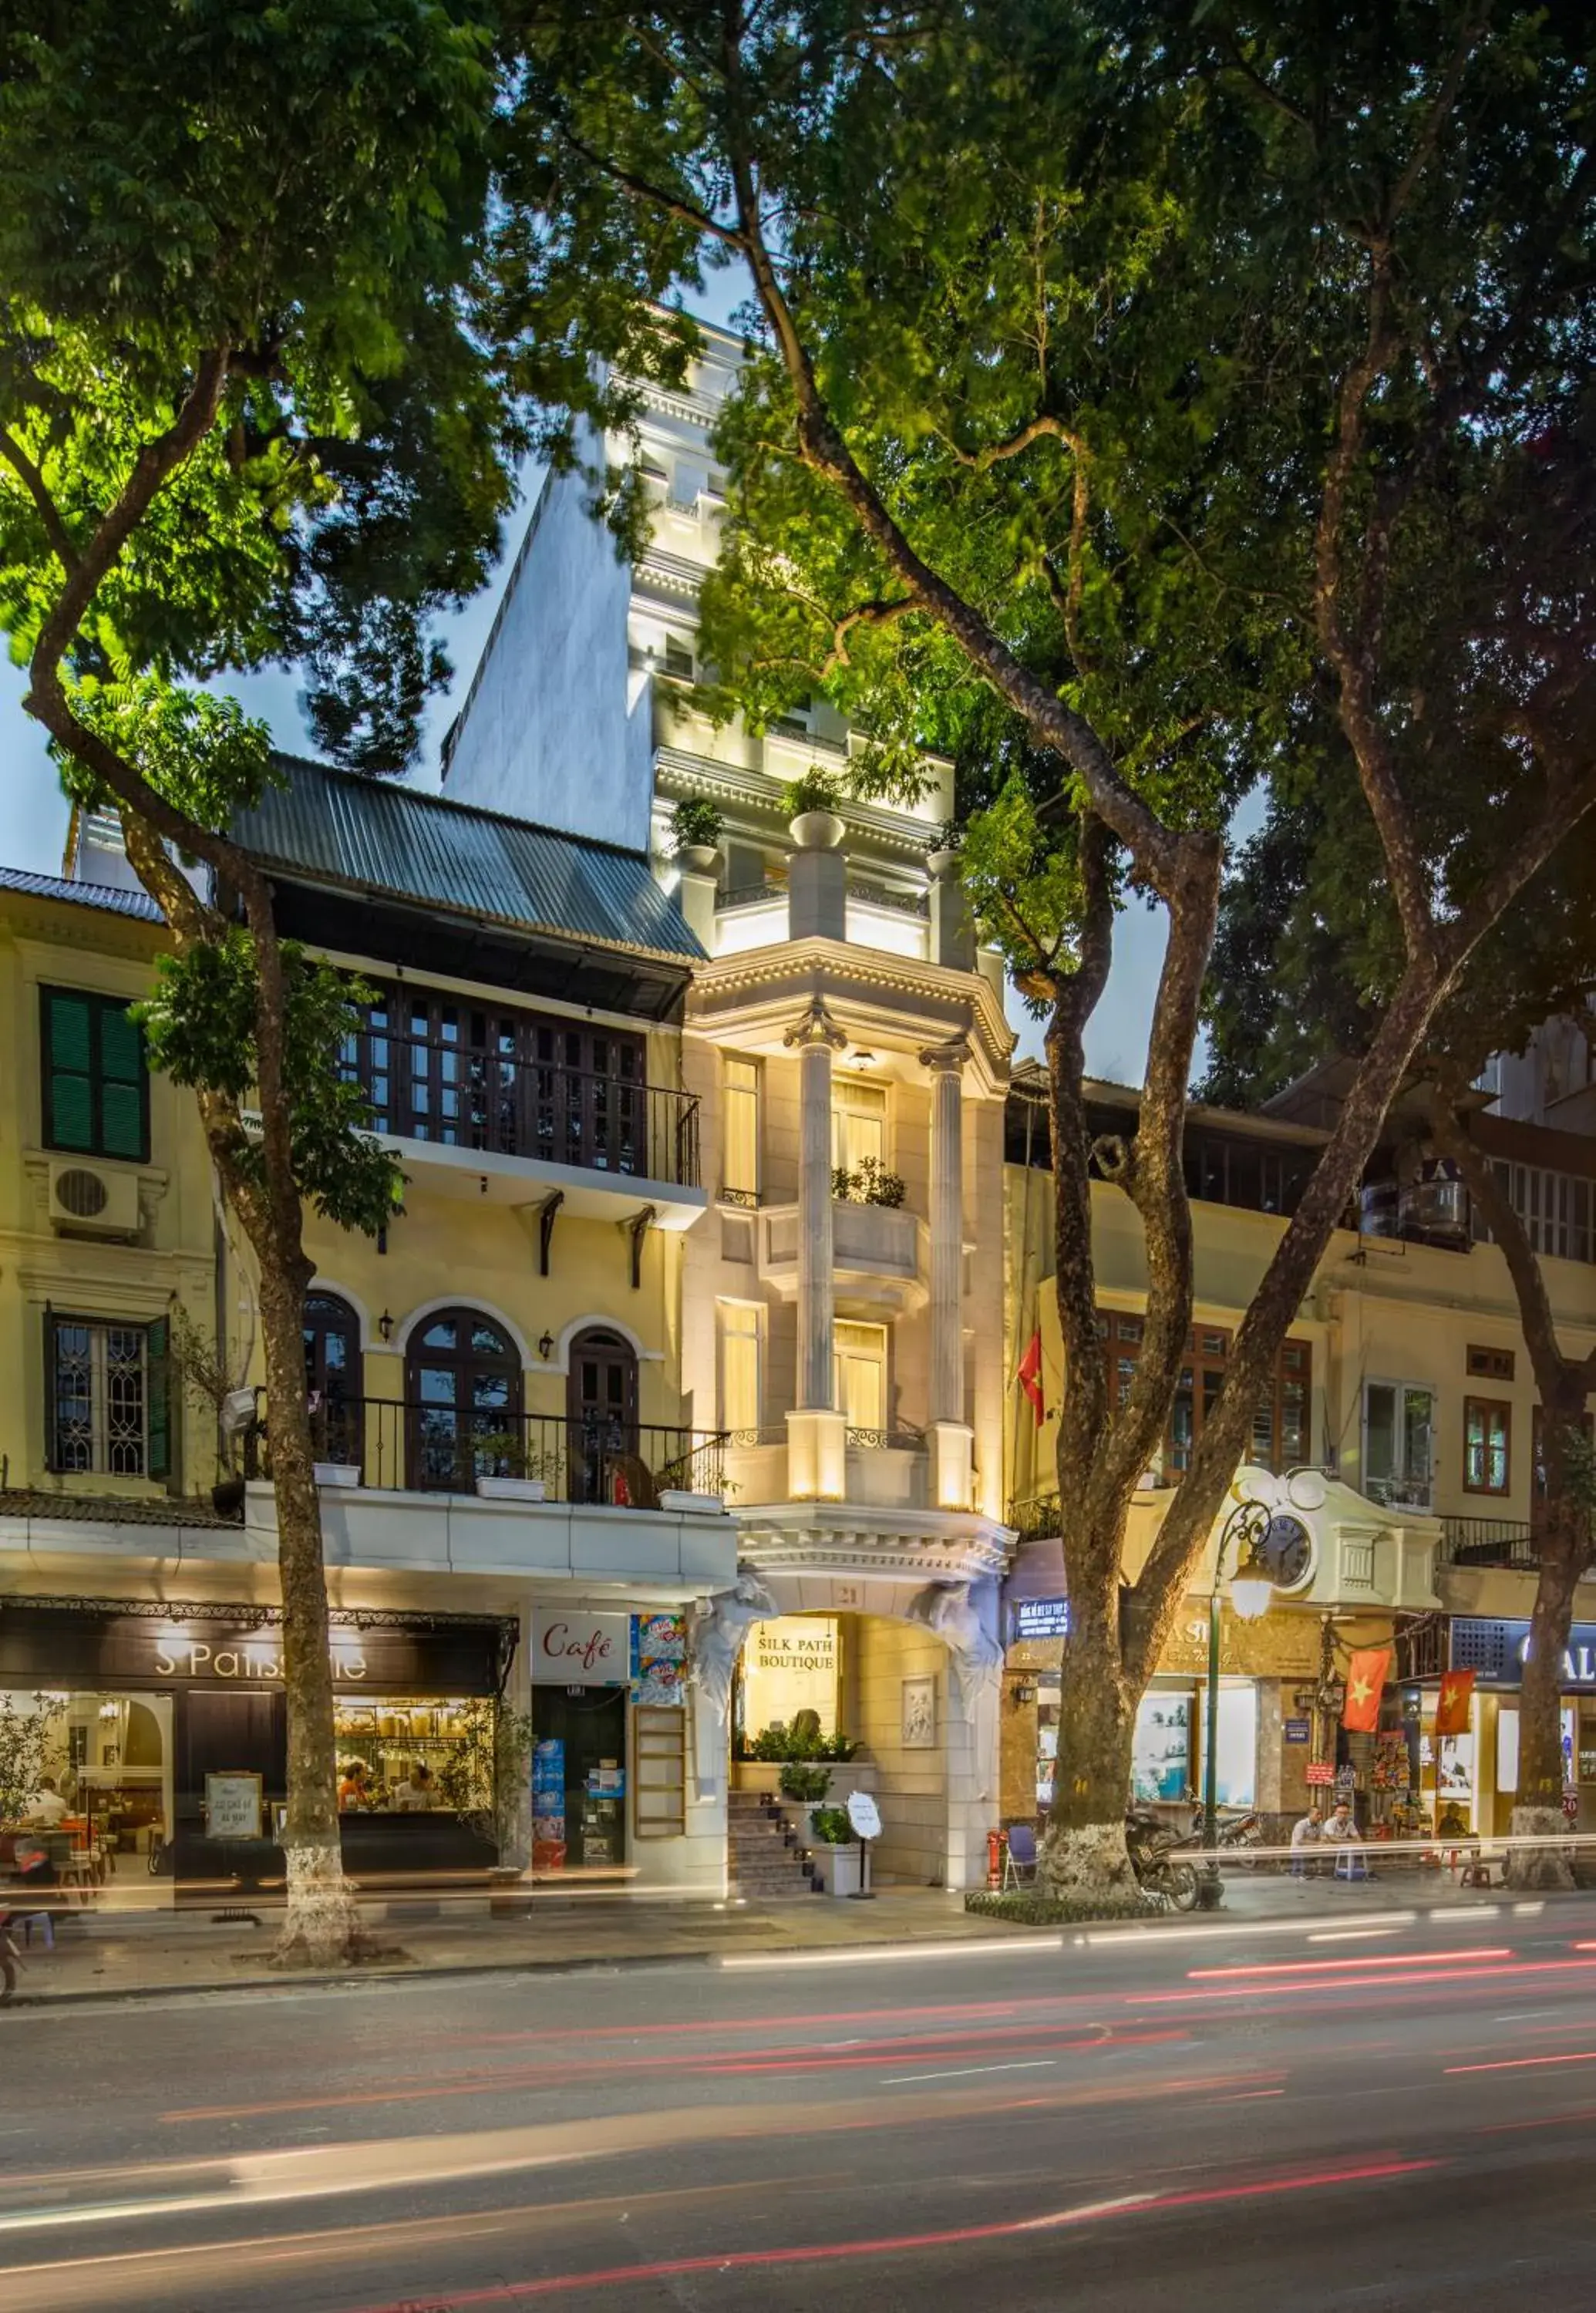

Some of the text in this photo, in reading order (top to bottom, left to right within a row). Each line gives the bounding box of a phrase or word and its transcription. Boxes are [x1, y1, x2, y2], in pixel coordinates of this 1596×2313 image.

[838, 1587, 857, 1604] 21
[544, 1623, 612, 1670] Café
[759, 1638, 833, 1652] SILK PATH
[759, 1655, 834, 1671] BOUTIQUE
